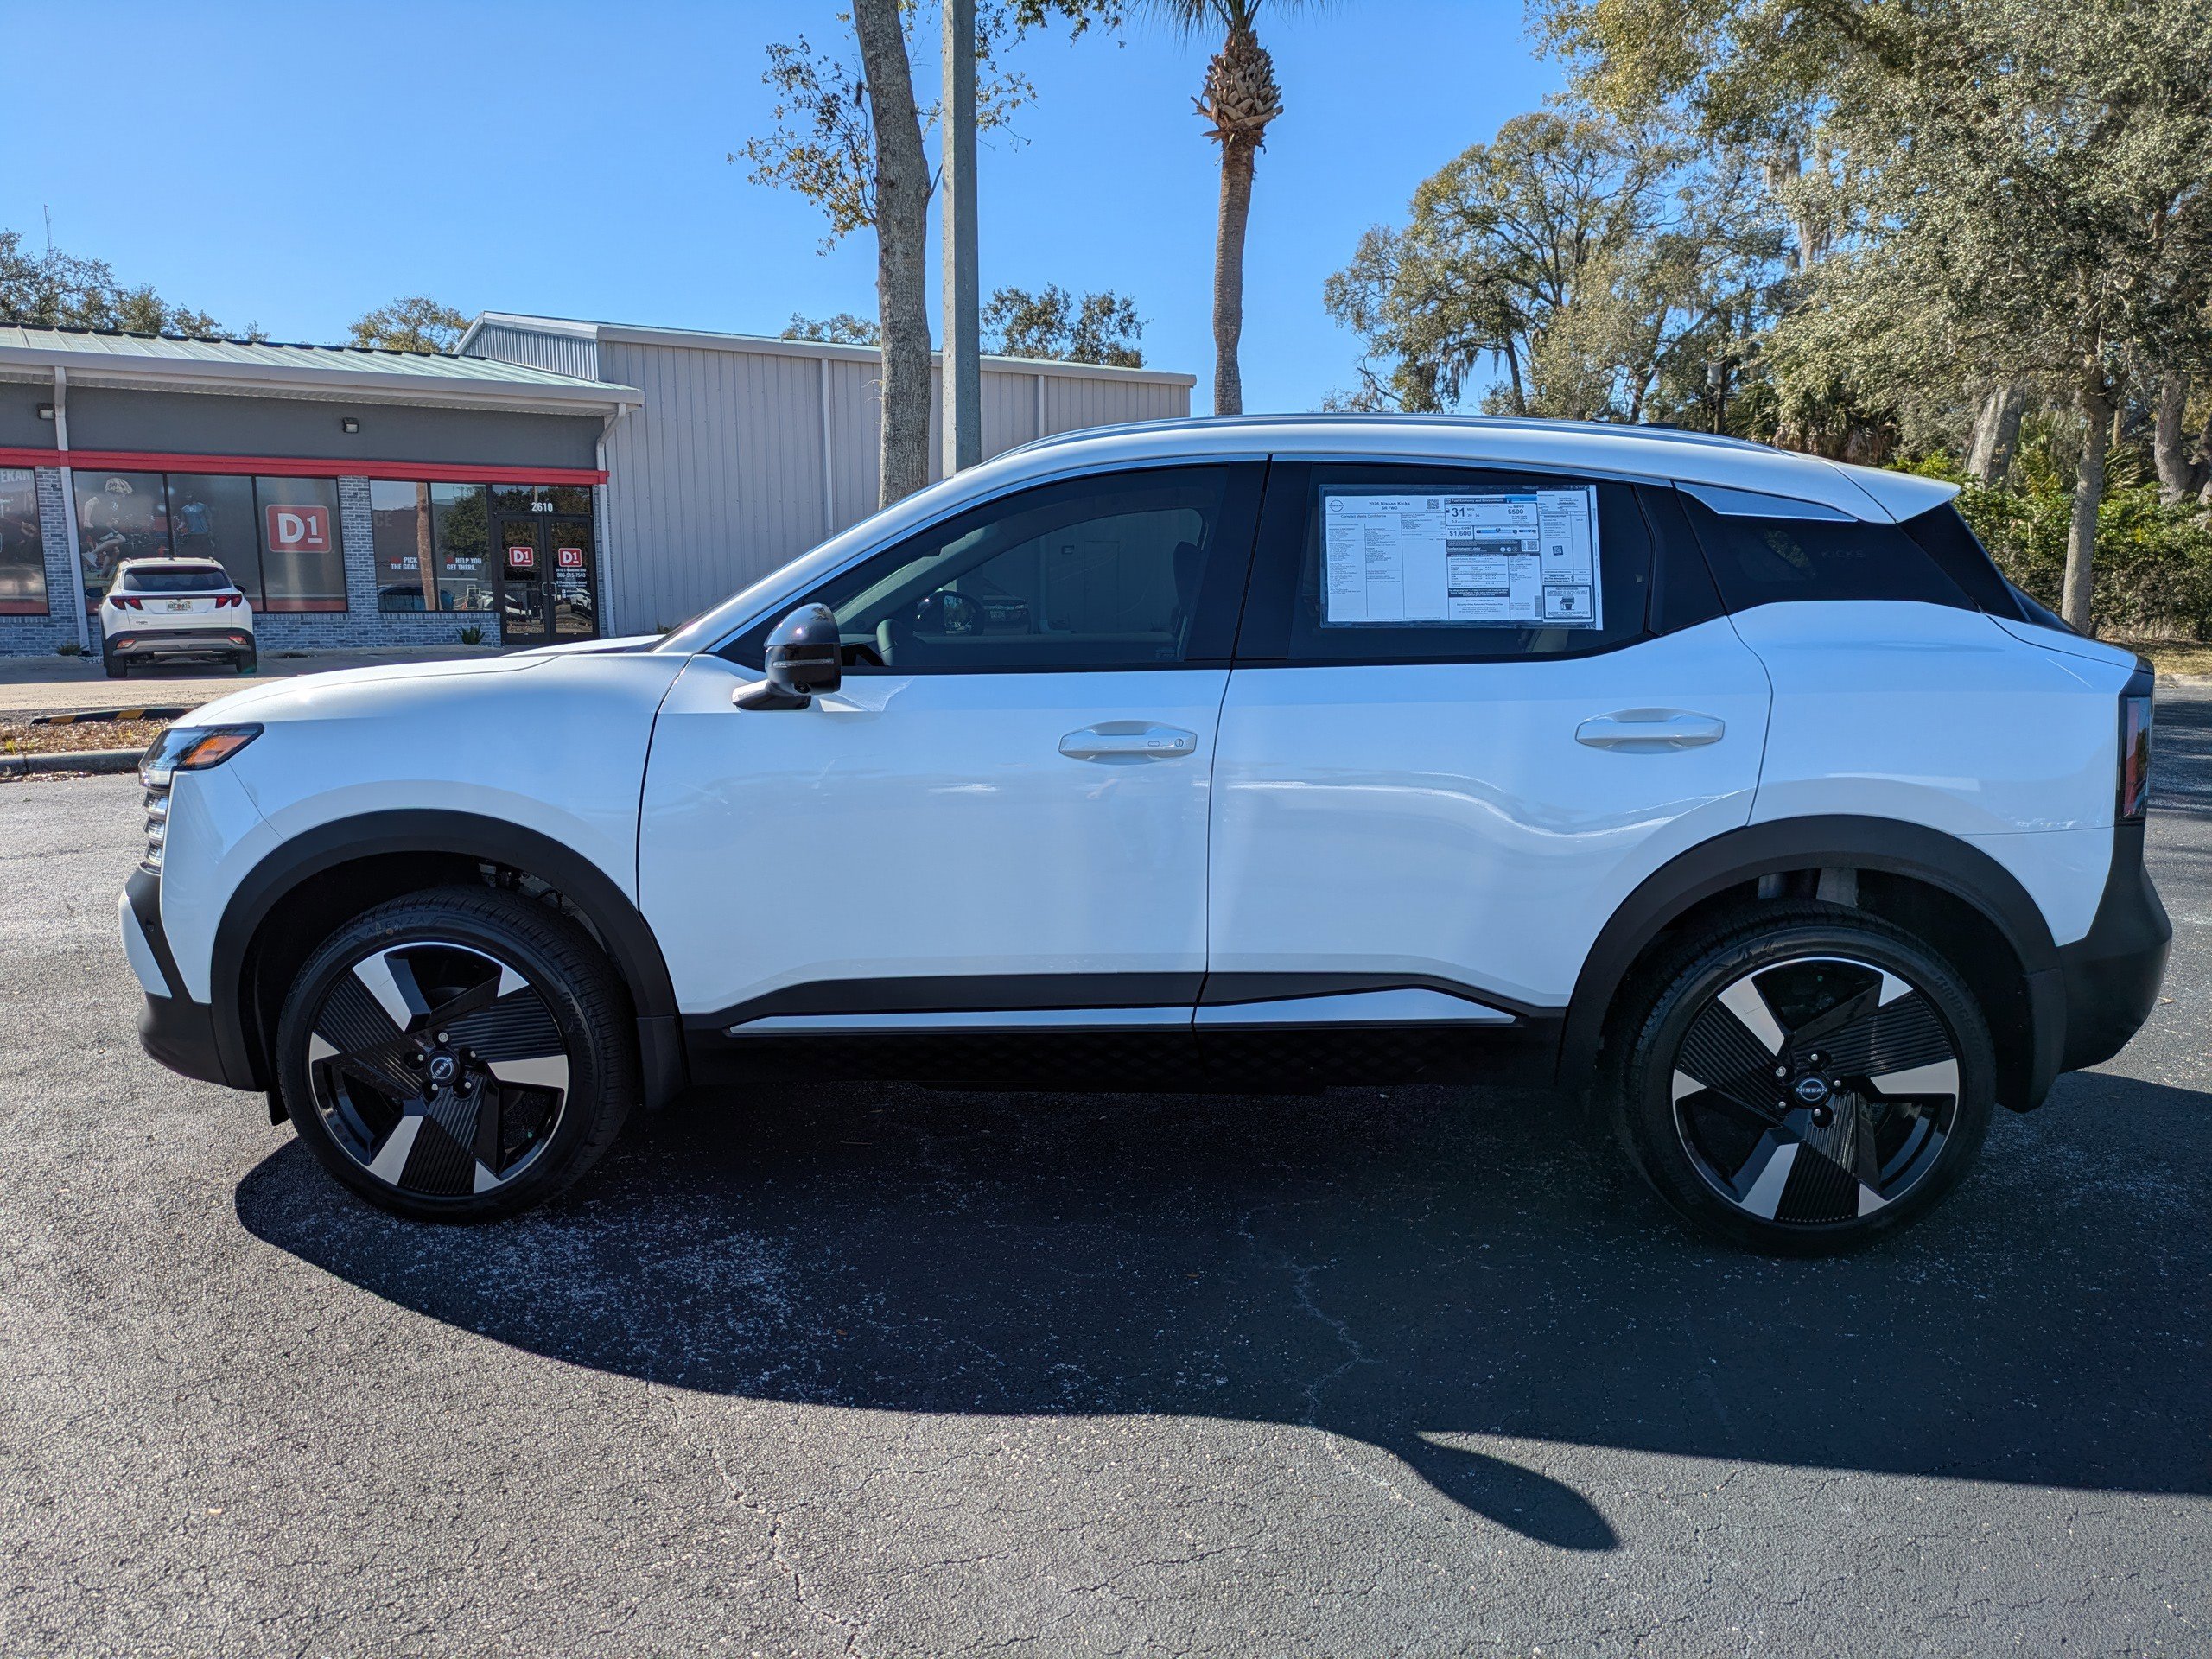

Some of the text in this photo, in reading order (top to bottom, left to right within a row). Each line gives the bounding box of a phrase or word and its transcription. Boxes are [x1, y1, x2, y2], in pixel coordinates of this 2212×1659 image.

[531, 502, 553, 512] 2610
[1452, 507, 1465, 518] 31
[277, 512, 323, 543] D1
[513, 550, 531, 563] D1
[563, 550, 579, 563] D1
